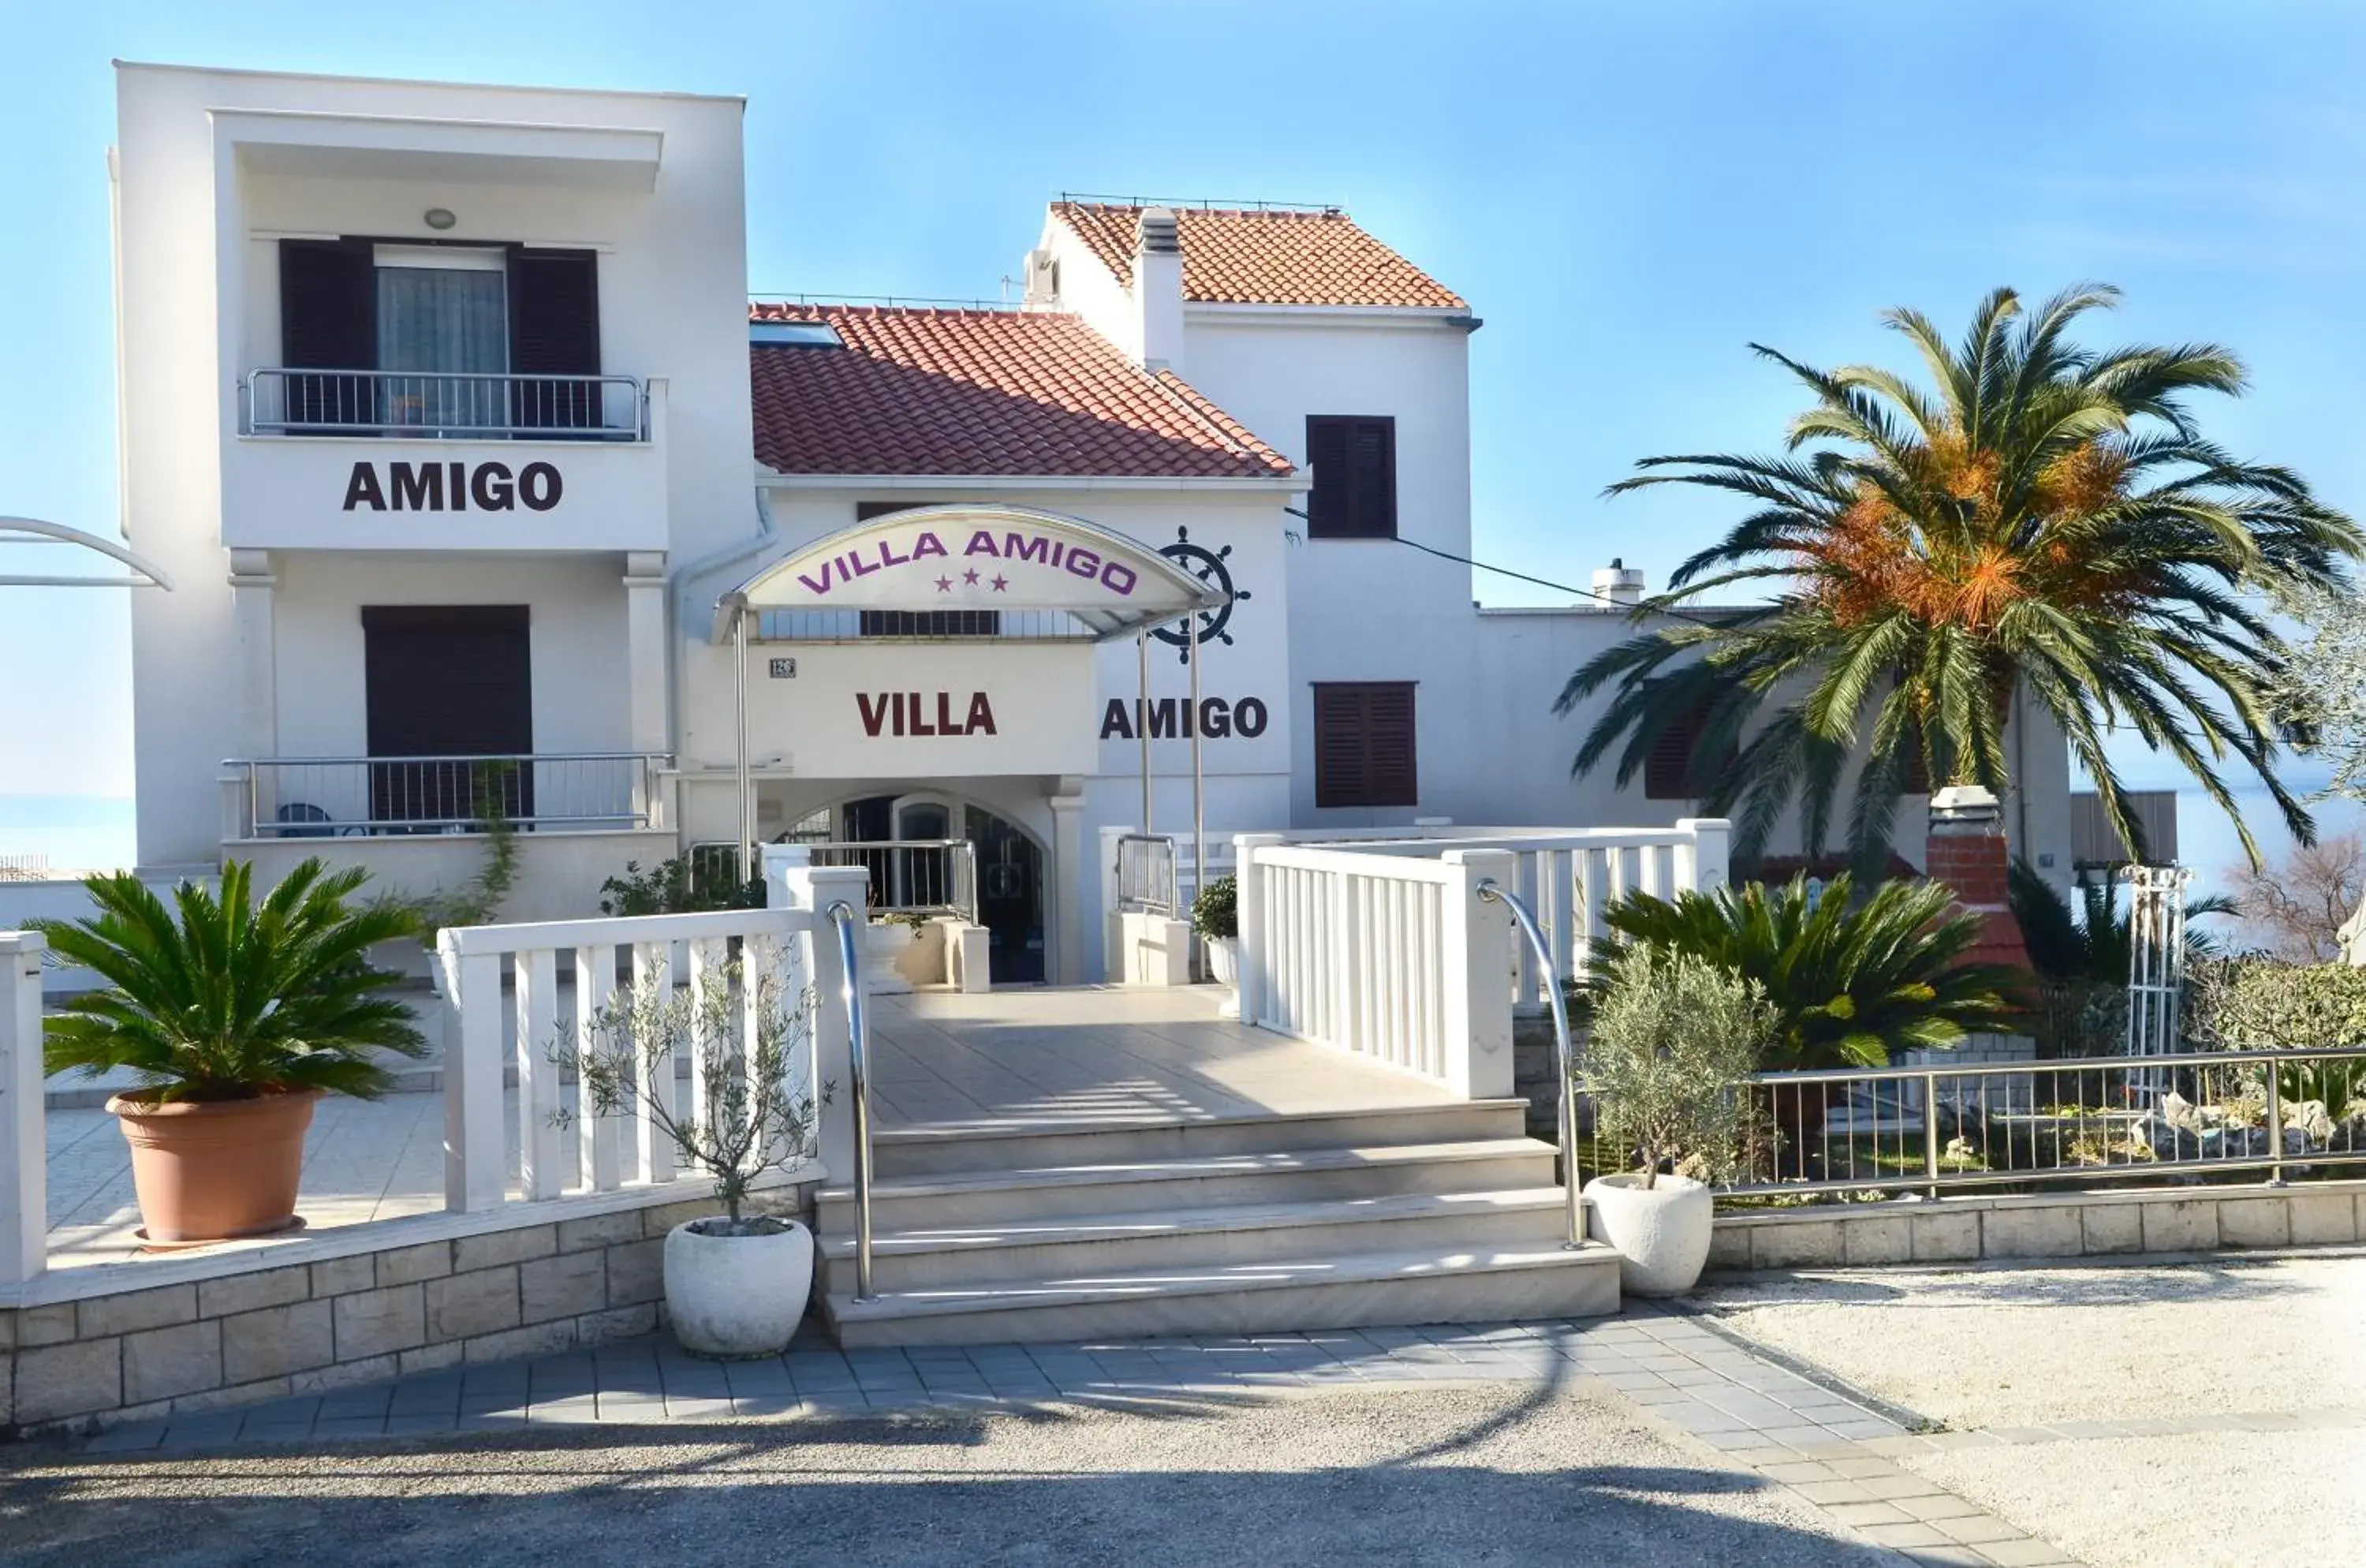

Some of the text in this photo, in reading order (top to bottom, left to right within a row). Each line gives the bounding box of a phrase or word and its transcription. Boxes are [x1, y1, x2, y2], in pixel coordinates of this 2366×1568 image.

[342, 461, 563, 512] AMIGO
[798, 531, 1137, 595] VILLA AMIGO
[856, 692, 998, 737] VILLA
[1099, 696, 1268, 739] AMIGO
